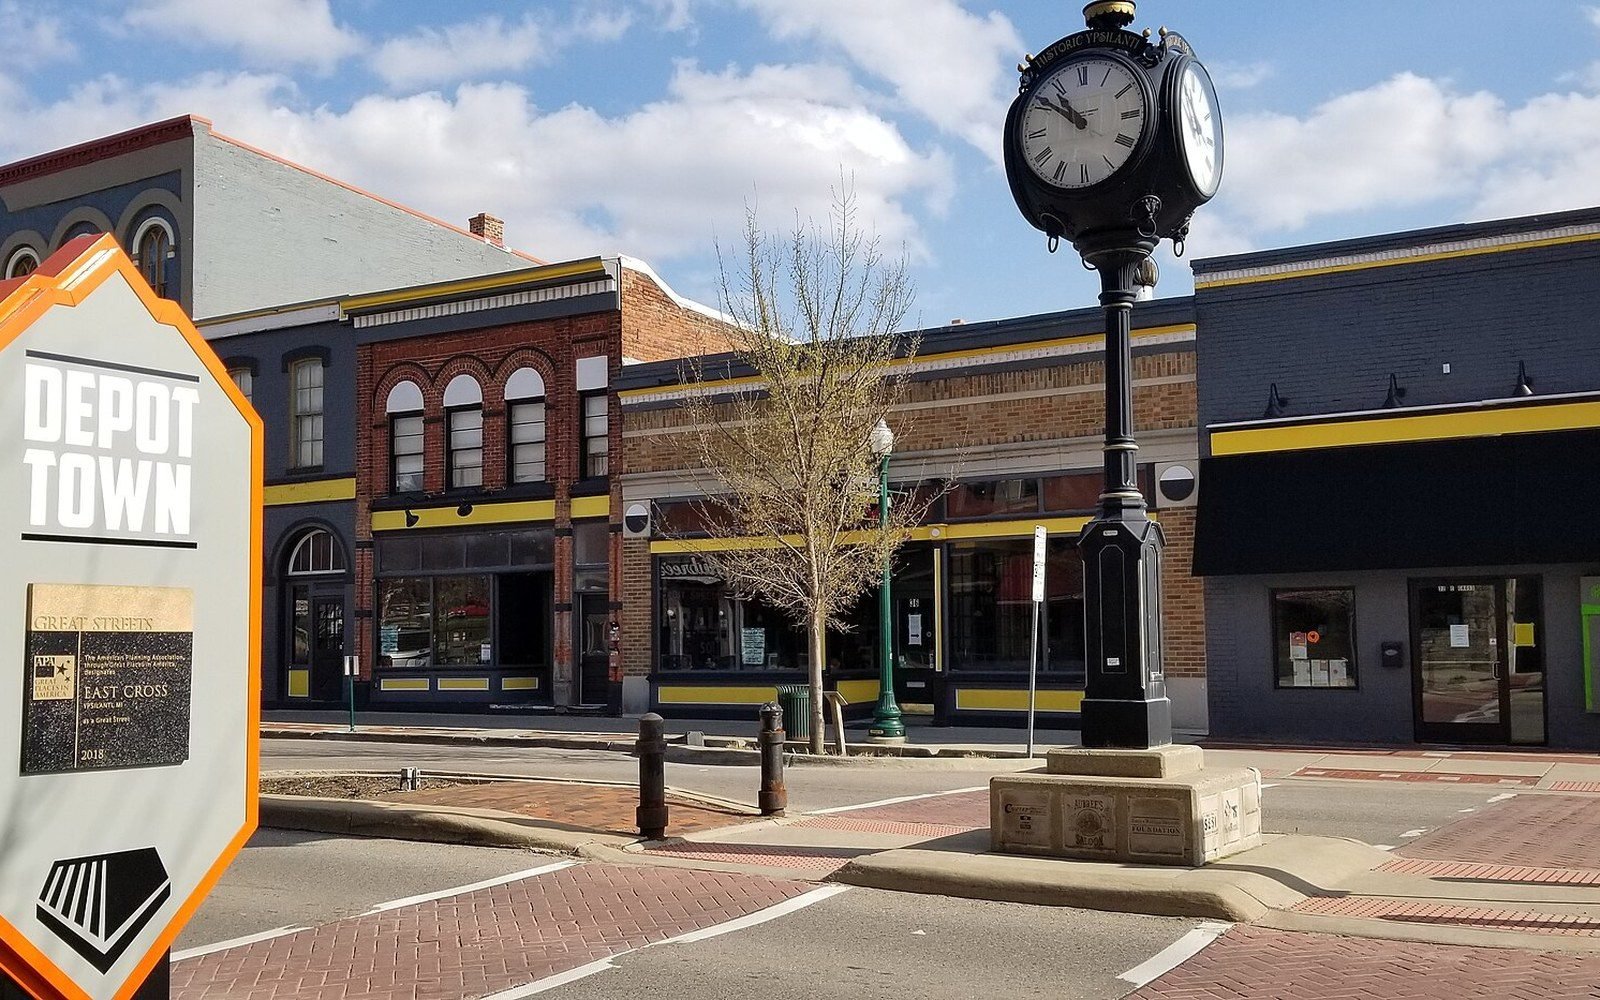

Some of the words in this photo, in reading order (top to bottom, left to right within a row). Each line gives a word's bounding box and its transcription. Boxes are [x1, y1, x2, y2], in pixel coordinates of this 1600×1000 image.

[1034, 35, 1083, 68] HISTORIC
[1084, 31, 1141, 49] YPSILANTI
[23, 363, 201, 459] DEPOT
[22, 448, 193, 535] TOWN
[33, 615, 87, 631] GREAT
[92, 616, 153, 631] STREETS
[36, 657, 55, 667] APA
[96, 654, 124, 662] American
[125, 654, 151, 662] Planning
[84, 686, 119, 700] EAST
[123, 684, 169, 699] CROSS
[81, 749, 104, 761] 2018
[1131, 824, 1180, 835] FOUNDATION
